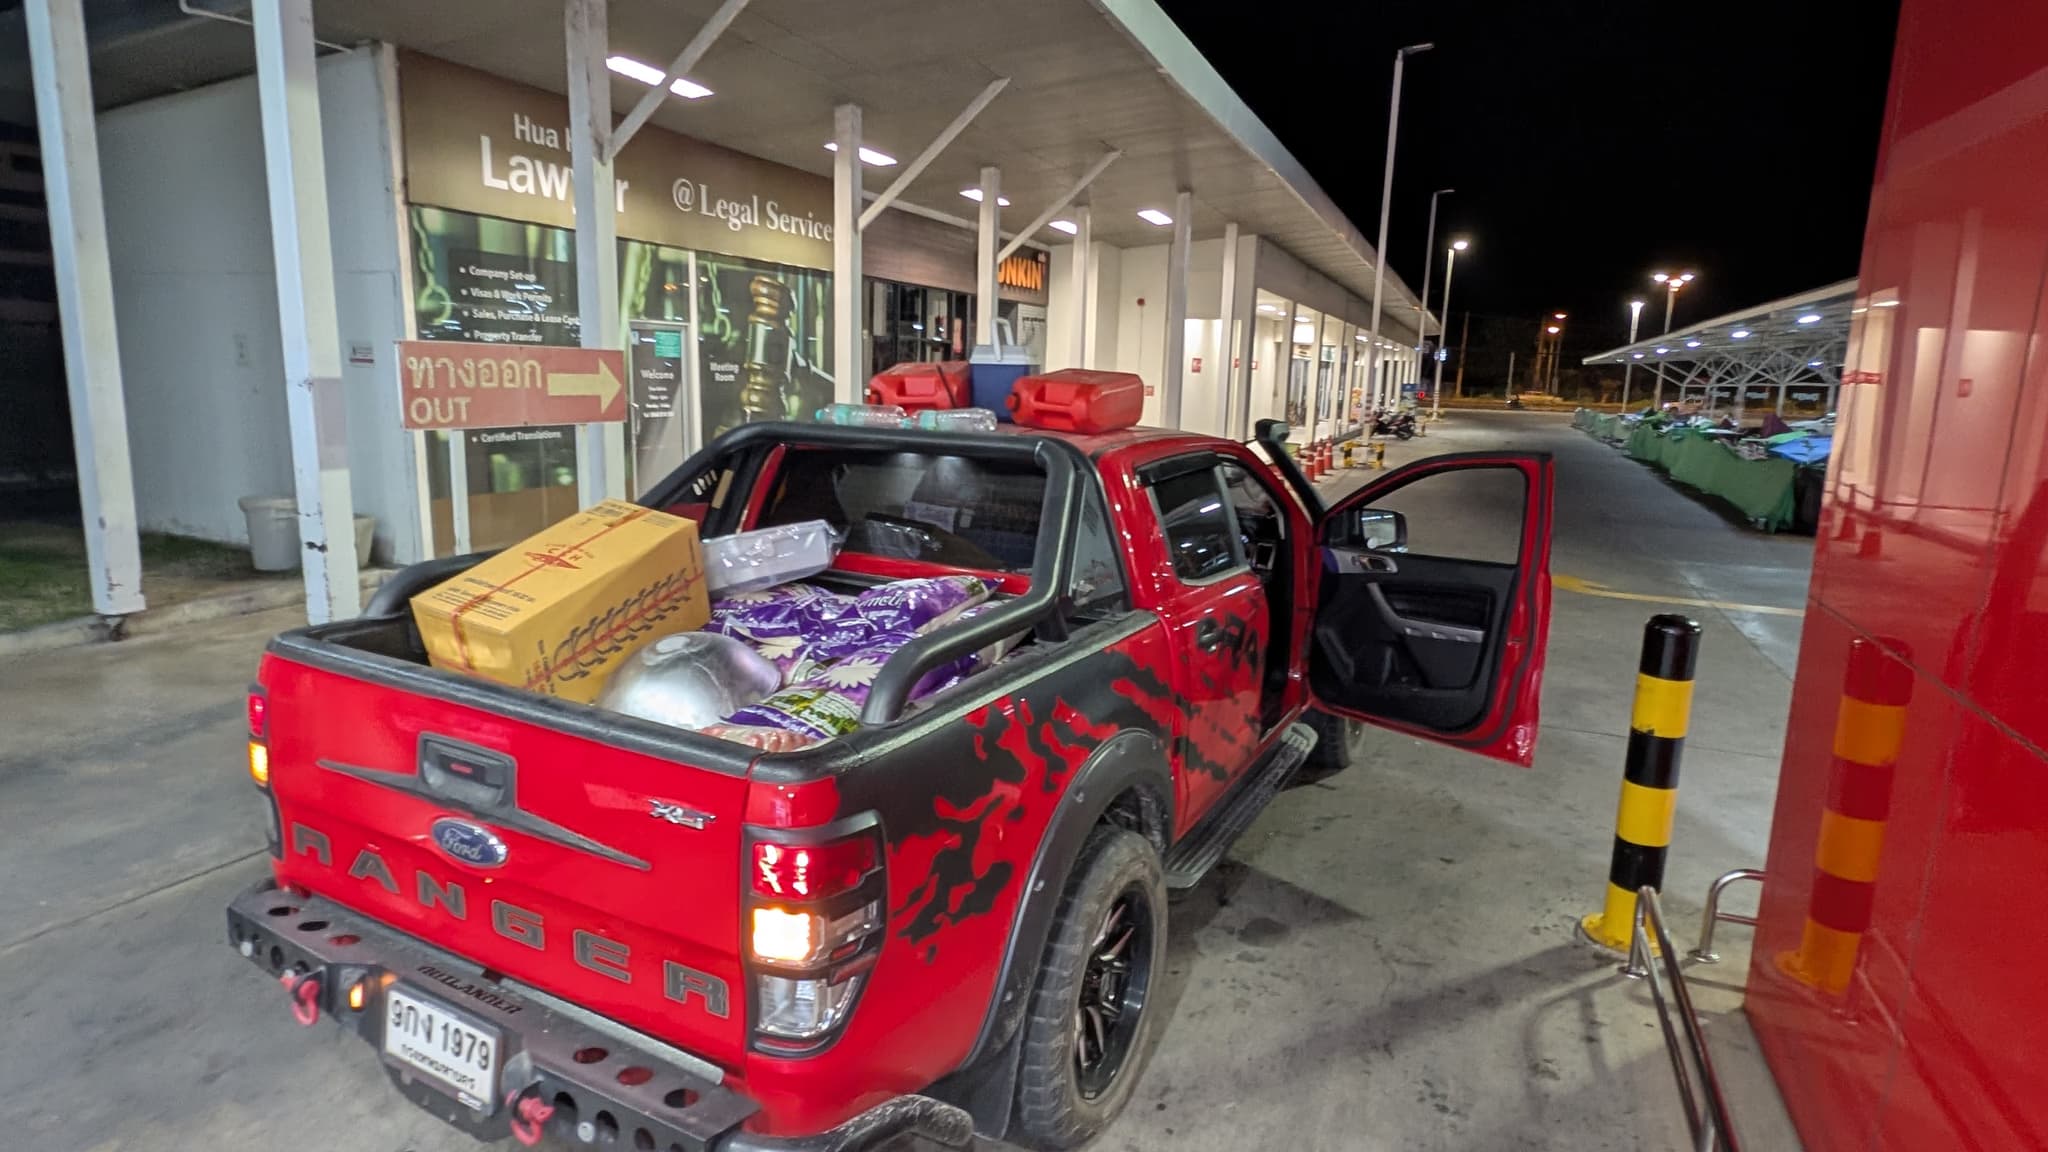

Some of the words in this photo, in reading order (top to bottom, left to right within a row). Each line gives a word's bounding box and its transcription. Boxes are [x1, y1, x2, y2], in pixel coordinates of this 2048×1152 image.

[513, 113, 560, 150] Hua
[480, 133, 629, 216] Lawr
[672, 178, 696, 212] @
[699, 183, 760, 231] Legal
[469, 265, 508, 281] Company
[997, 255, 1042, 291] UNKIN
[470, 287, 493, 299] Visas
[494, 288, 500, 299] &
[523, 291, 552, 303] Permits
[497, 310, 533, 321] Purchase
[534, 313, 540, 322] &
[541, 313, 562, 323] Lease
[473, 330, 510, 342] Property
[510, 331, 543, 342] Transfer
[406, 356, 542, 389] ทางออก
[640, 369, 674, 379] Welcome
[710, 362, 739, 374] Meeting
[714, 372, 735, 381] Room
[410, 397, 471, 424] OUT
[480, 432, 516, 443] Certified
[517, 430, 561, 440] Translations
[442, 827, 484, 860] Ford
[292, 821, 731, 1019] RANGER
[441, 1022, 490, 1071] 1979
